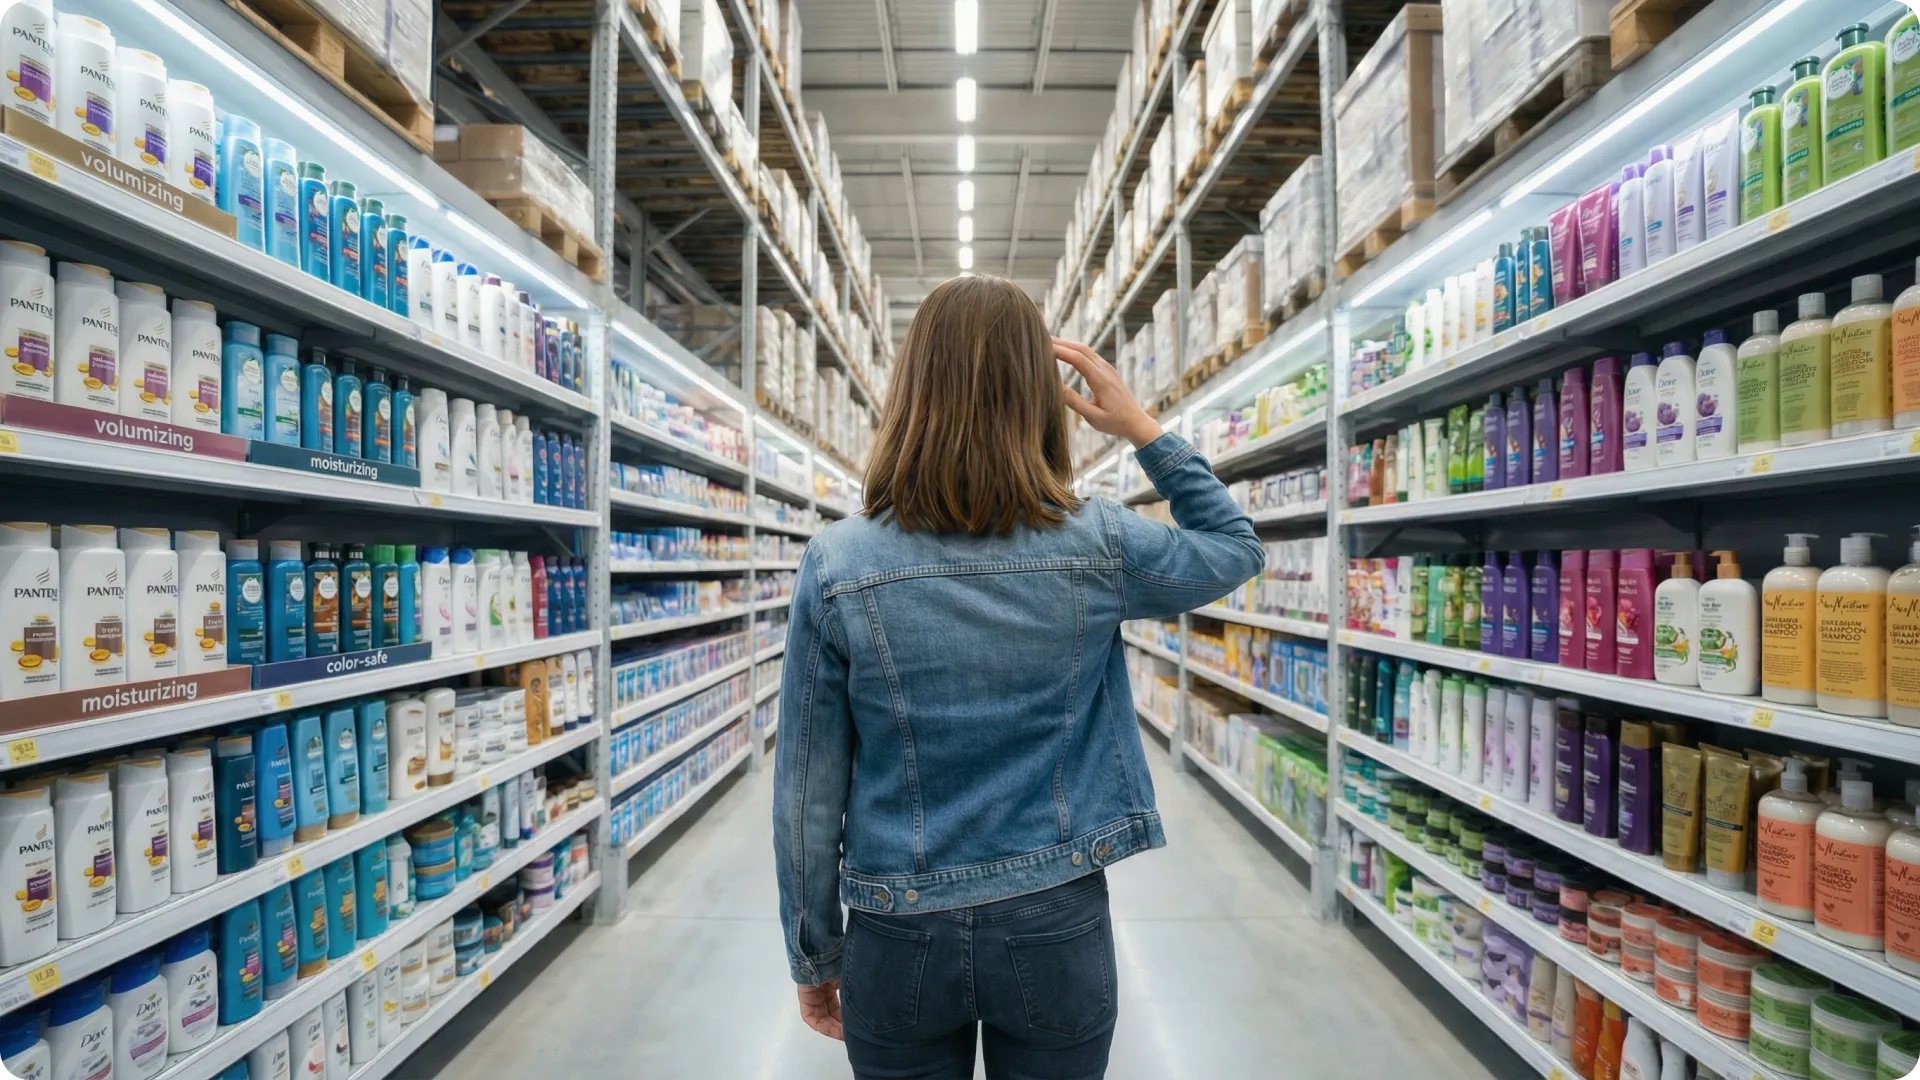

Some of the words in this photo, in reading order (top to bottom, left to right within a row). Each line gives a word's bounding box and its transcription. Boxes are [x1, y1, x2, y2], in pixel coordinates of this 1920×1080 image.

[79, 150, 184, 213] volumizing
[94, 418, 194, 452] volumizing
[310, 456, 378, 480] moisturizing
[14, 587, 58, 598] PANTEN
[326, 650, 388, 674] color-safe
[81, 679, 198, 713] moisturizing
